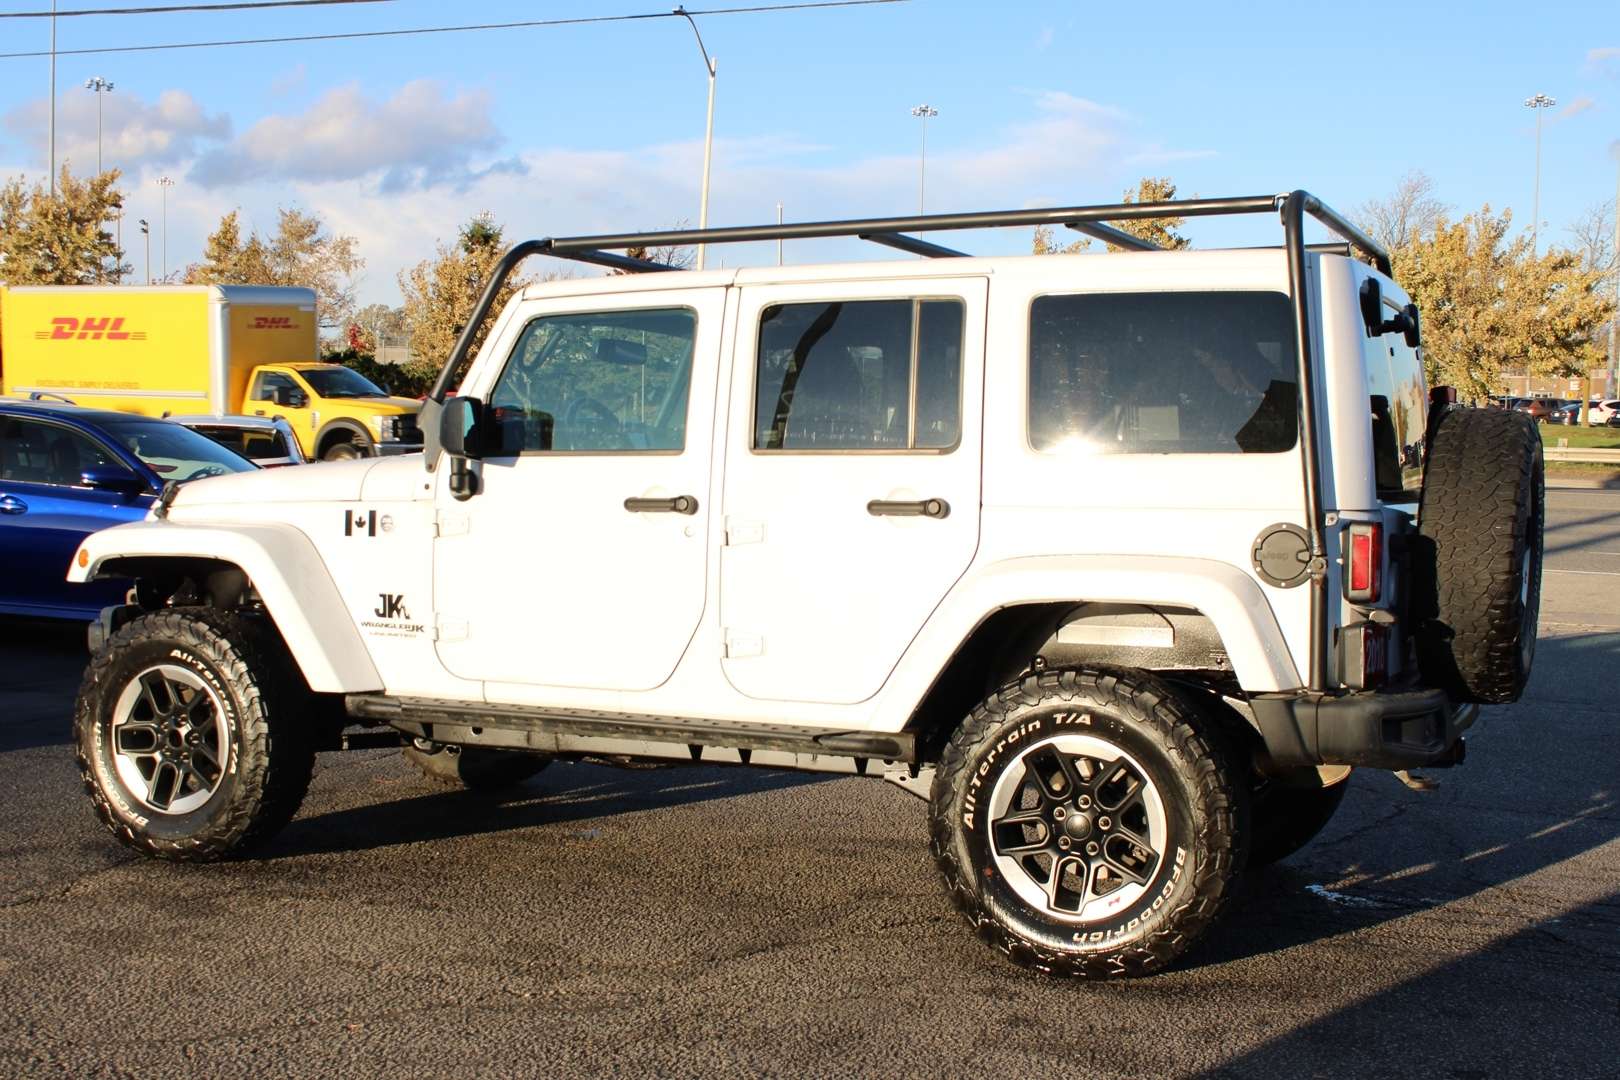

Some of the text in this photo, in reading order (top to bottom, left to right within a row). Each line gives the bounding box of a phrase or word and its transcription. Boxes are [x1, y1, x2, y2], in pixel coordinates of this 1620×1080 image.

[50, 317, 130, 340] DHL
[254, 317, 292, 329] DHL
[963, 712, 1092, 830] All-Terrain T/A
[1072, 846, 1186, 943] BFGoodrich
